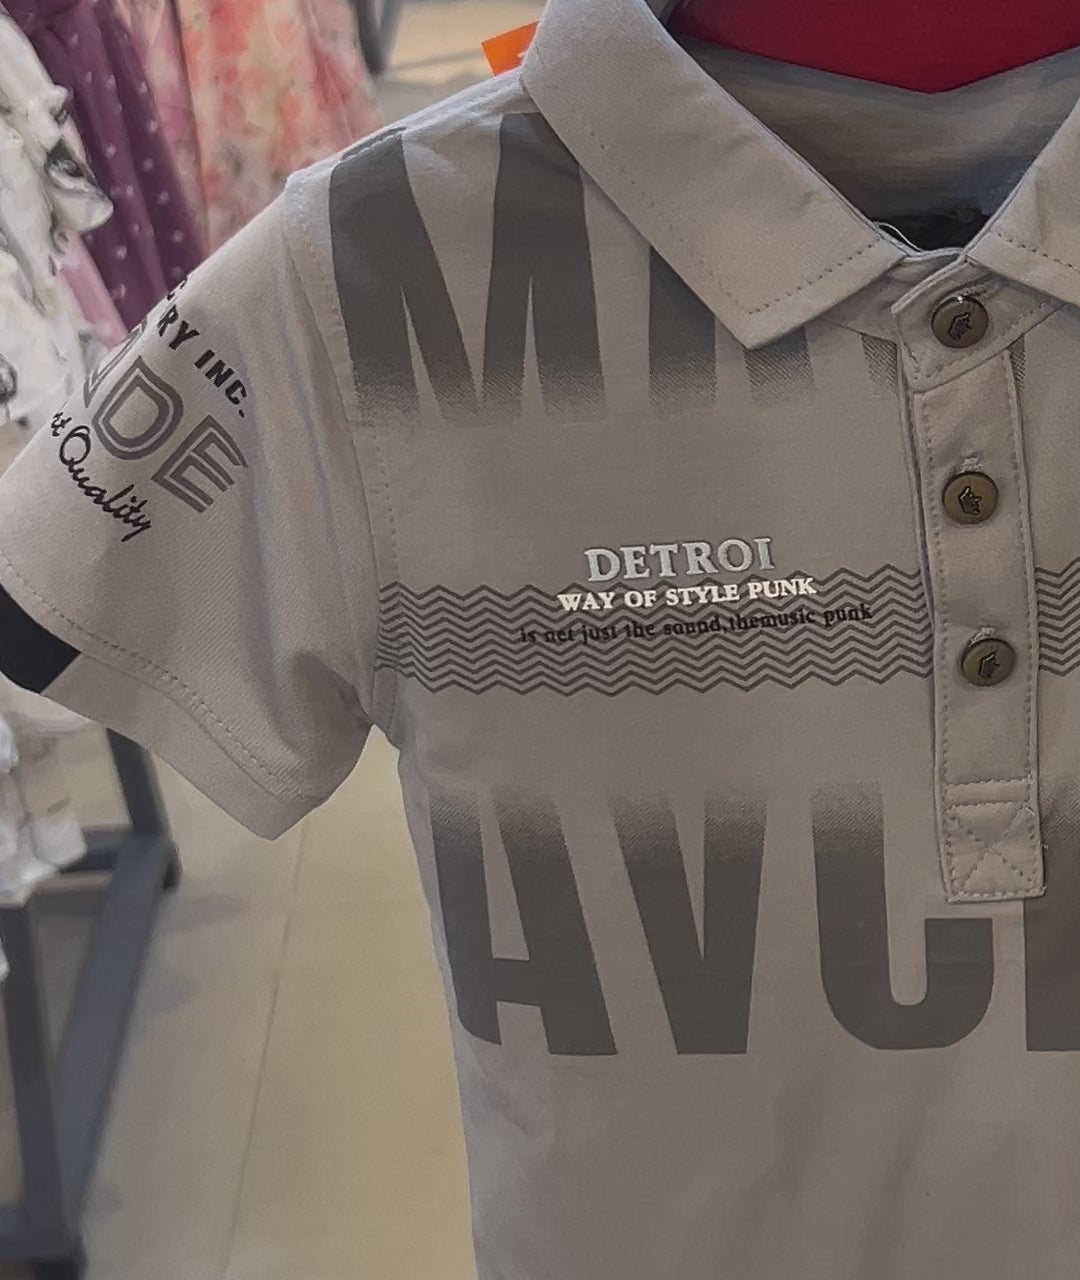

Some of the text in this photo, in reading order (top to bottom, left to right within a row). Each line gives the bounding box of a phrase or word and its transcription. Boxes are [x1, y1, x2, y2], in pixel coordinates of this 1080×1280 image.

[157, 280, 248, 418] RY INC.
[84, 320, 249, 513] DE
[59, 425, 152, 543] Quality
[557, 577, 817, 612] WAY OF STYLE PUNK
[584, 537, 776, 583] DETROI
[520, 627, 537, 644] is
[582, 624, 618, 646] just
[625, 620, 656, 639] the
[823, 603, 873, 627] punk
